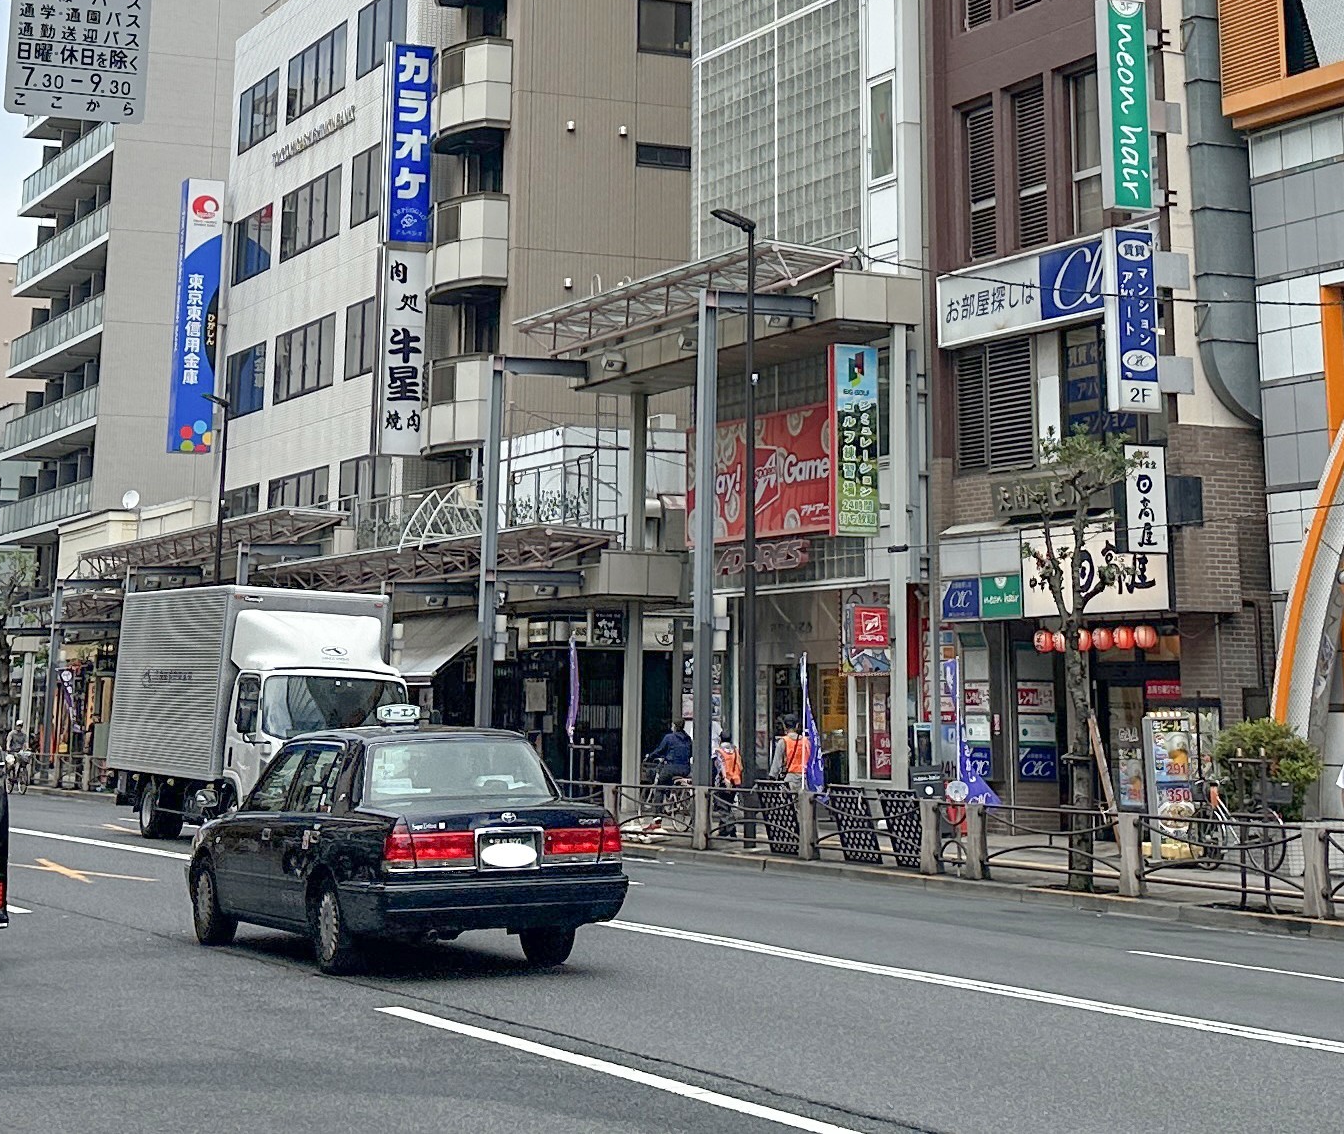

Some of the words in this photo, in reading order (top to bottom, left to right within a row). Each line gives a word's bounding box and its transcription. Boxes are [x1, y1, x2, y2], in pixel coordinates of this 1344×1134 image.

[18, 21, 140, 47] 通勤送迎バス
[1117, 23, 1135, 115] neon
[14, 93, 135, 116] ここから
[394, 52, 429, 199] カラオケ
[1120, 125, 1148, 200] hair
[945, 278, 1035, 324] お部屋探しは
[1121, 271, 1135, 336] アパート
[1137, 267, 1152, 346] マンション
[182, 273, 205, 385] 東京東信用金庫
[205, 314, 217, 346] ひがしん
[387, 328, 422, 402] 牛星
[384, 408, 421, 432] 焼肉
[1130, 388, 1152, 404] 2F
[784, 455, 830, 484] Game
[843, 402, 856, 497] ゴルフ練習場
[859, 400, 872, 497] シミュレーション
[842, 499, 873, 512] 24時間
[1136, 474, 1157, 547] 日高屋
[384, 707, 418, 717] オーエス
[1167, 788, 1190, 802] 350
